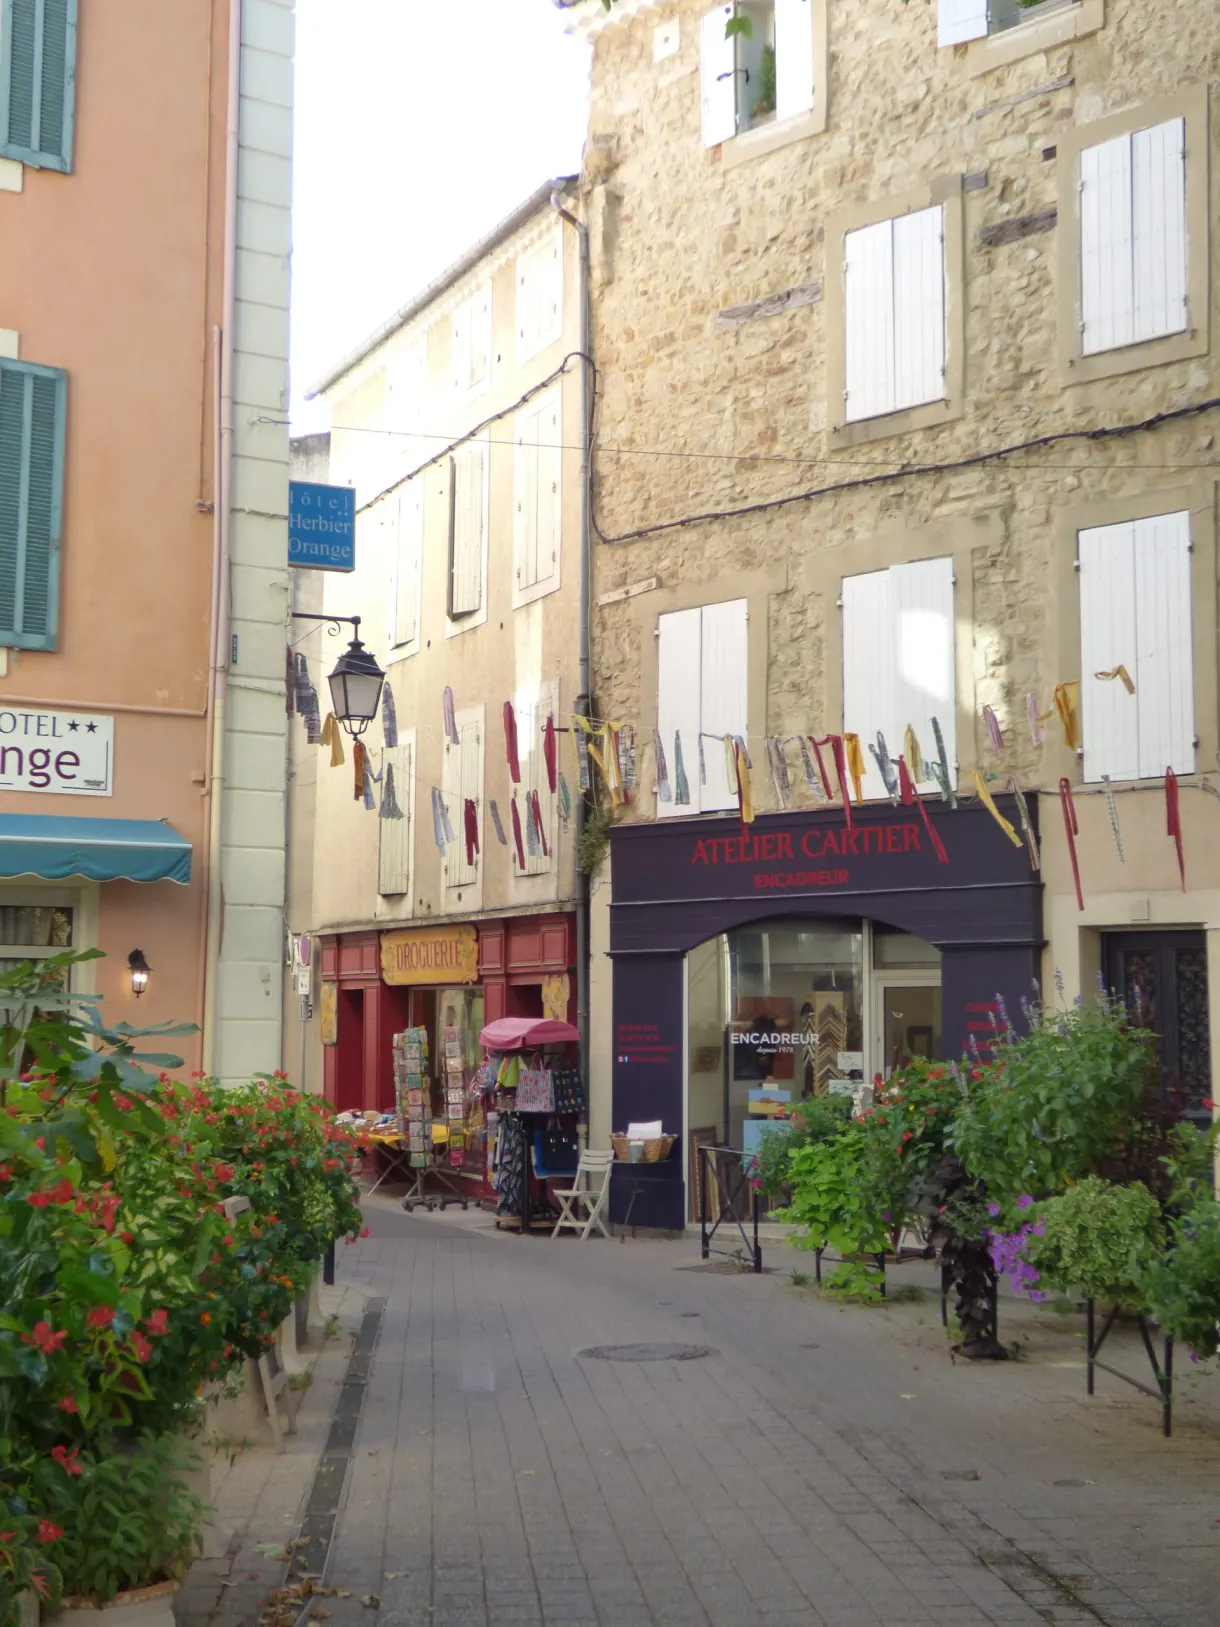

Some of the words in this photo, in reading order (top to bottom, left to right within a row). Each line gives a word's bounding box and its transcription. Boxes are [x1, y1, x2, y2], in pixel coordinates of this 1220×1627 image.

[289, 513, 352, 534] Herbier
[288, 537, 351, 561] Orange
[0, 711, 63, 738] OTEL
[0, 746, 80, 788] nge
[691, 832, 794, 866] ATELIER
[801, 823, 922, 858] CARTIER
[753, 869, 849, 889] ENCADREUR
[396, 939, 462, 971] DROGUERIE
[730, 1032, 821, 1045] ENCADREUR
[756, 1045, 778, 1055] depuis
